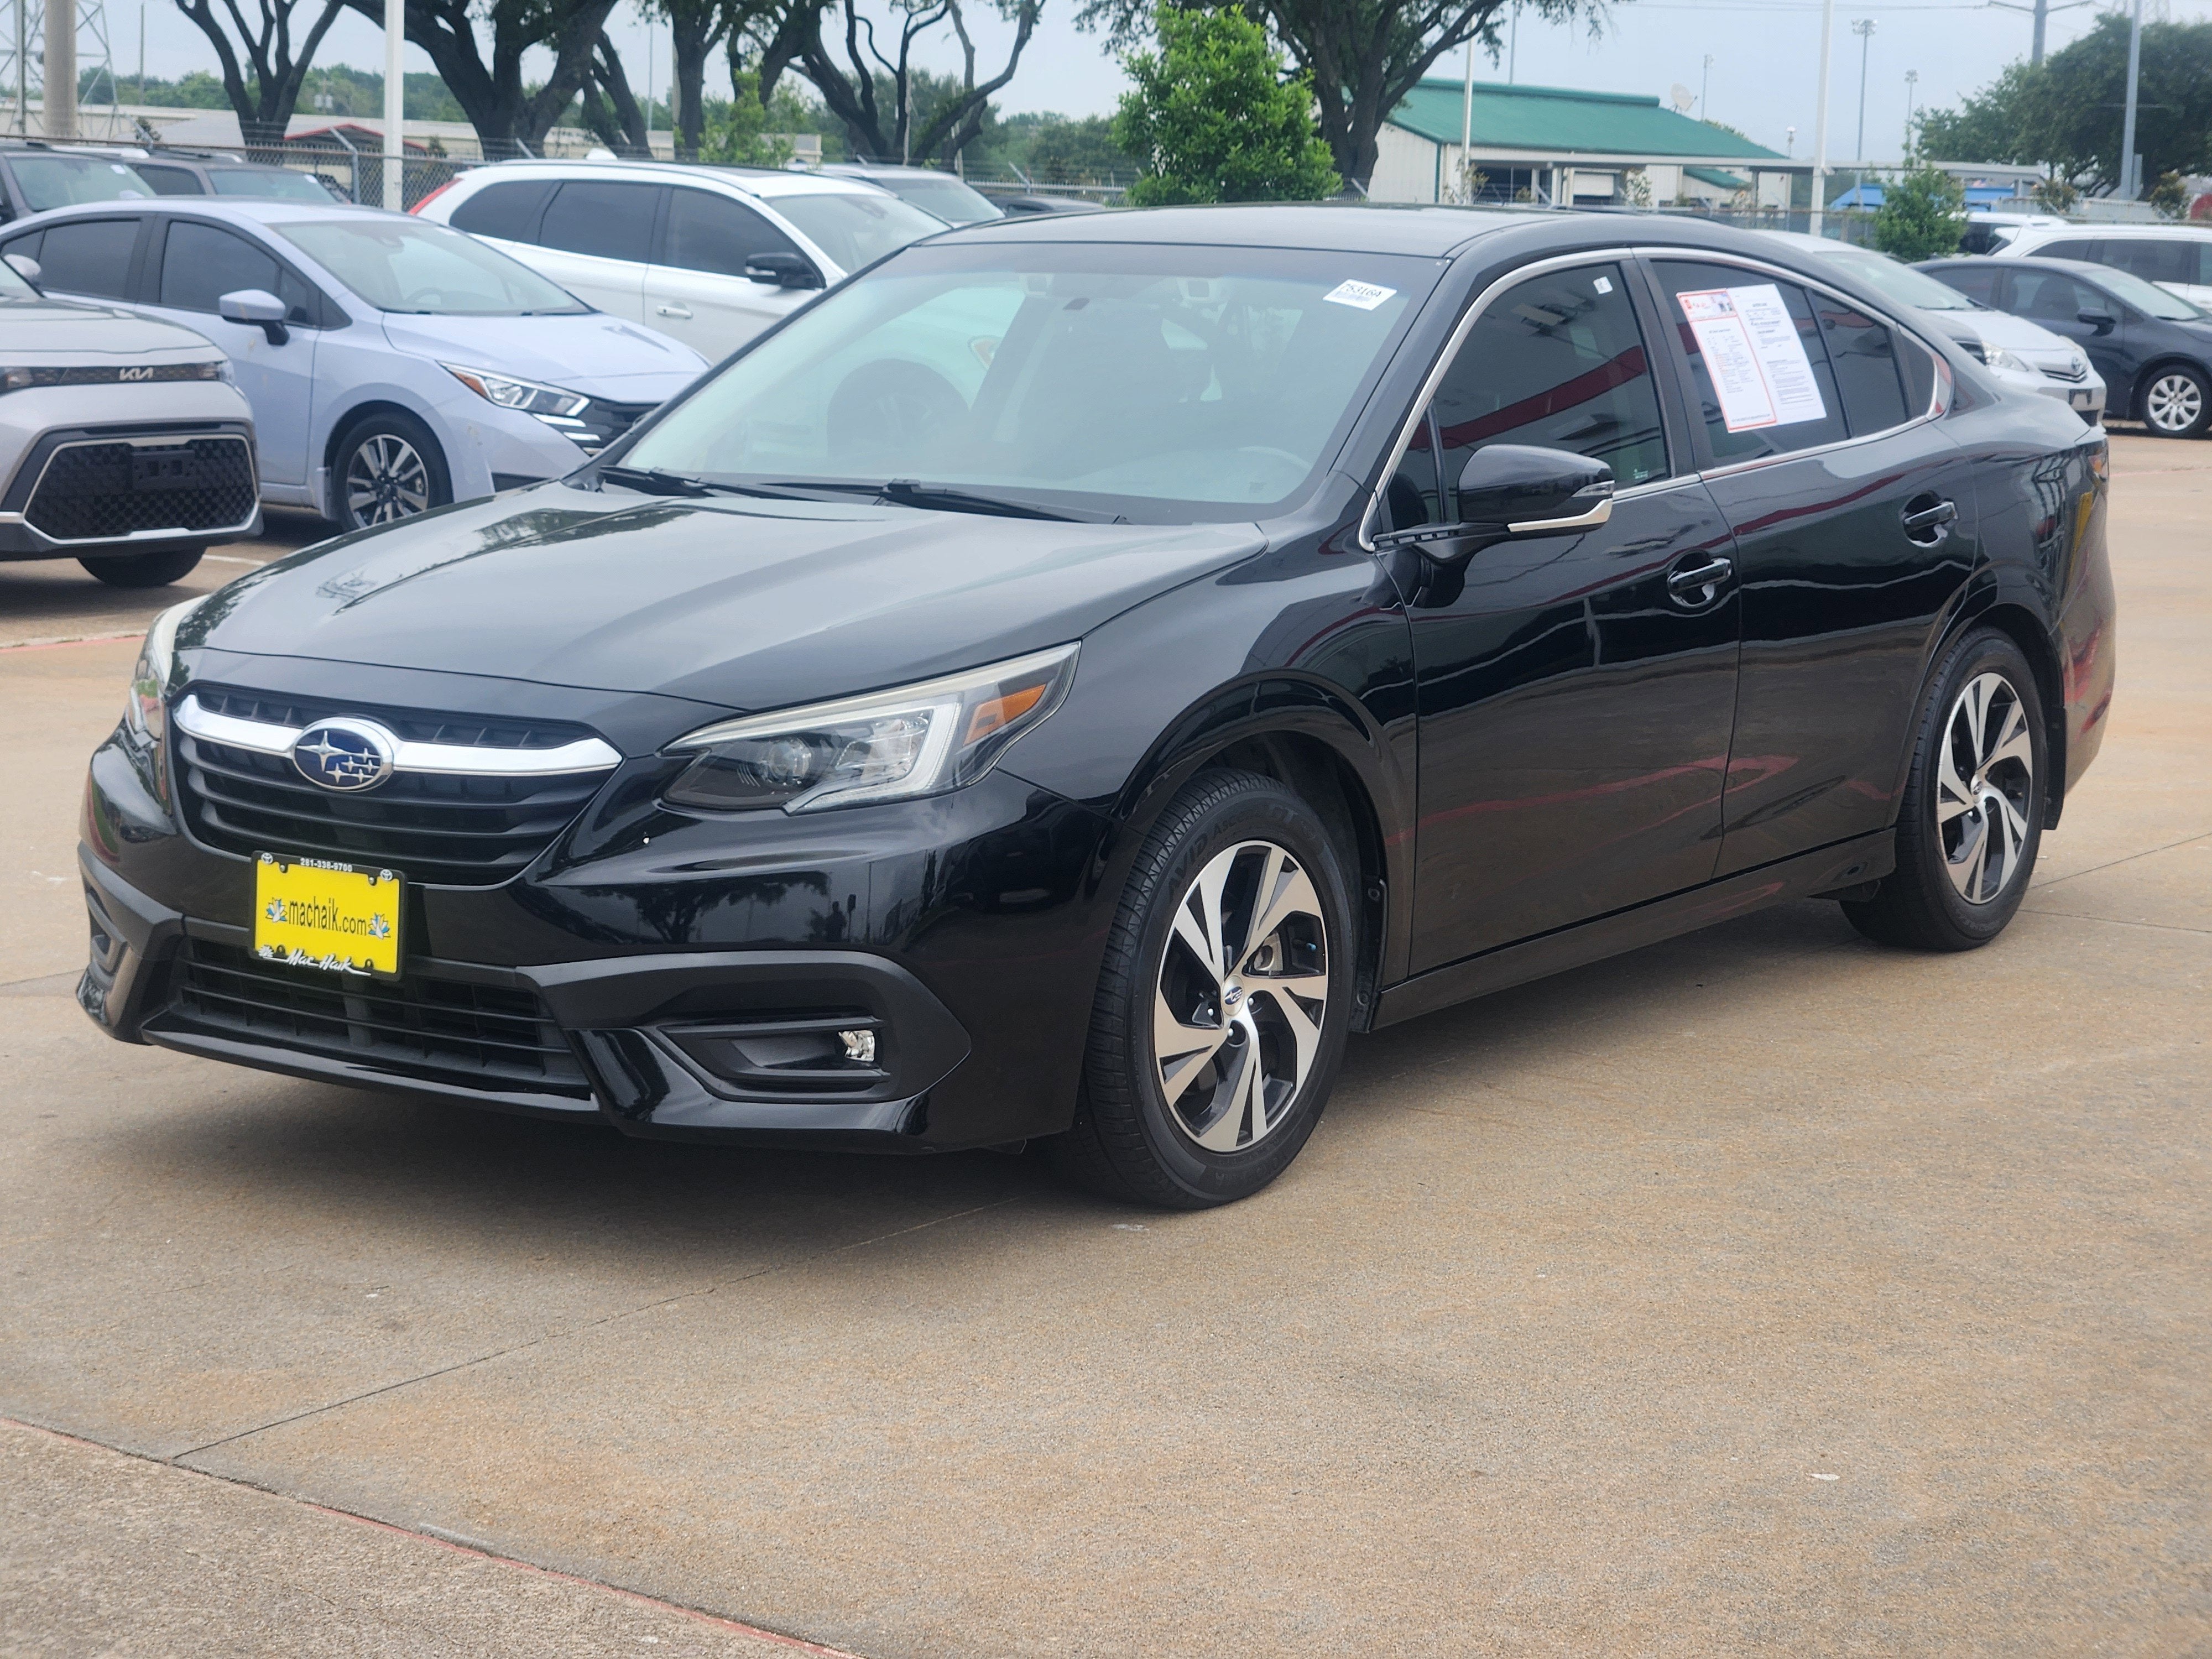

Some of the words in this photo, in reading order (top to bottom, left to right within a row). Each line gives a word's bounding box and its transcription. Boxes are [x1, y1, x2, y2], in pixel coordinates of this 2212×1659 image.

[289, 896, 367, 936] machaik.com
[288, 948, 315, 966] Mac
[319, 953, 359, 972] Haik
